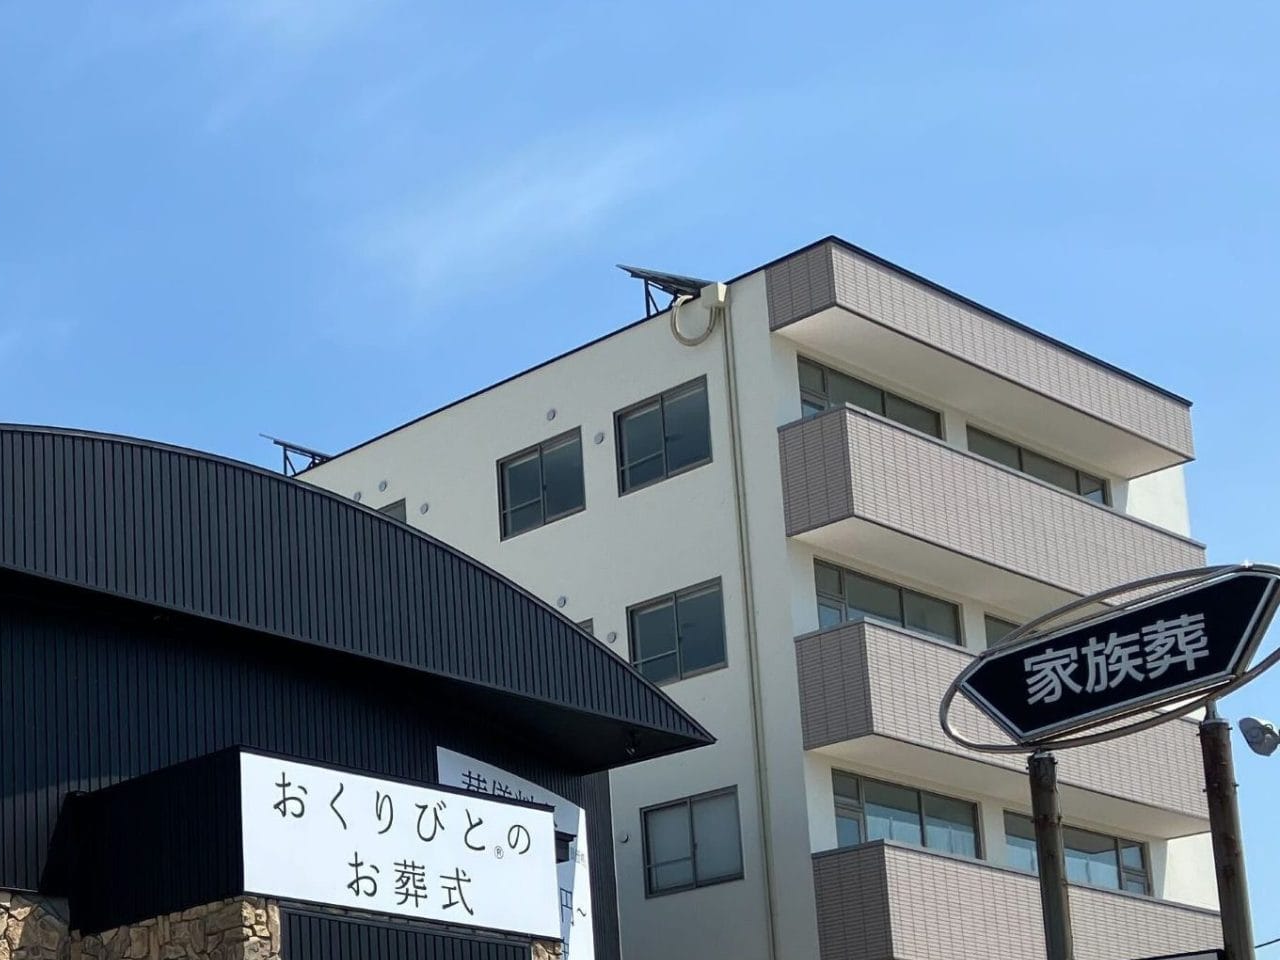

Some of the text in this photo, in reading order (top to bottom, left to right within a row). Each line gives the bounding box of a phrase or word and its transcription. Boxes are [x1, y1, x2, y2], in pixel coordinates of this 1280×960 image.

[1024, 613, 1210, 705] 家族葬
[347, 851, 474, 916] お葬式
